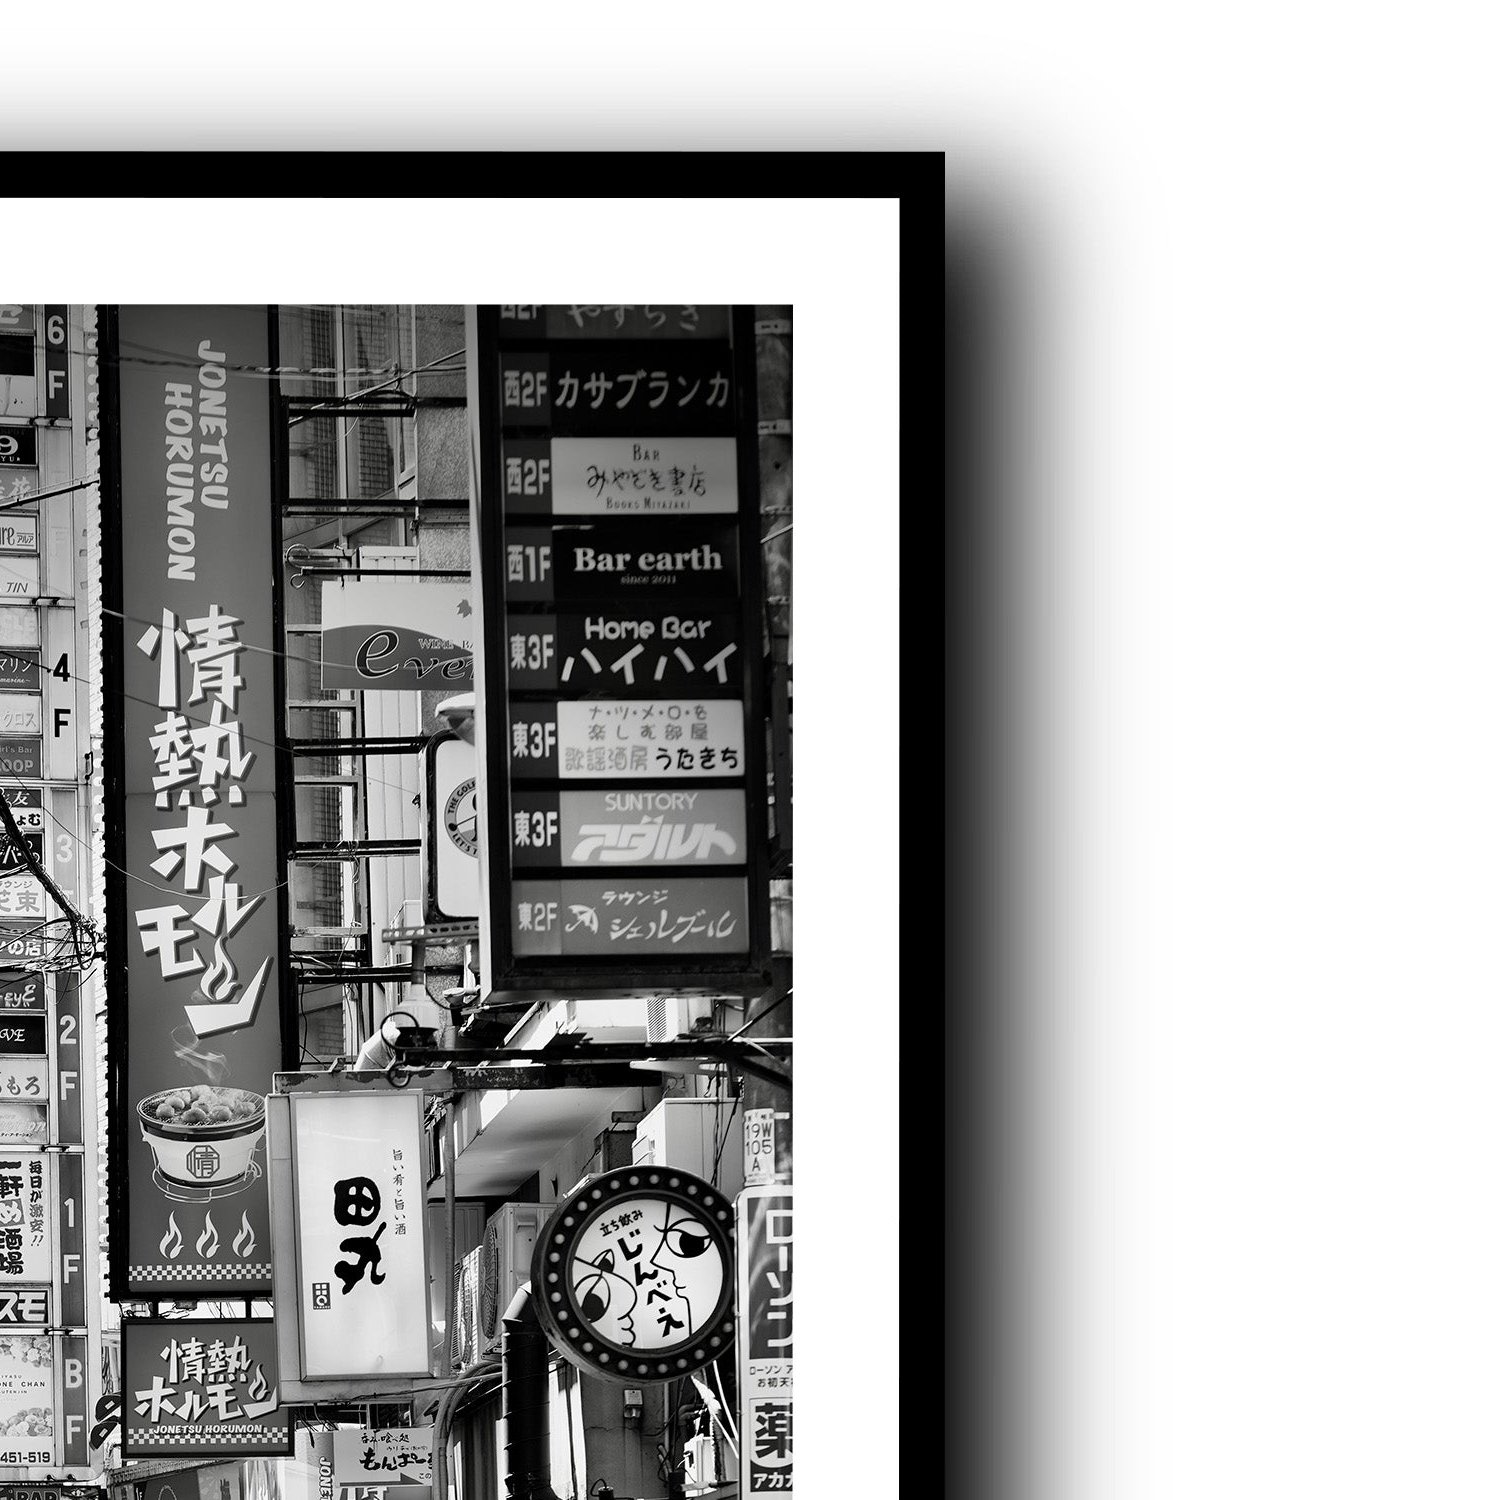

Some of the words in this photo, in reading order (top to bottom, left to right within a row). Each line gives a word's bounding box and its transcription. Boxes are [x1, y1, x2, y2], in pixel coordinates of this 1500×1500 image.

[504, 369, 548, 408] 西2F
[554, 368, 730, 409] カサブランカ
[197, 339, 229, 510] JONETSU
[164, 382, 197, 582] HORUMON
[506, 457, 551, 496] 西2F
[507, 544, 551, 583] 西1F
[573, 547, 632, 572] Bar
[638, 544, 723, 571] earth
[6, 582, 29, 593] TIN
[620, 573, 650, 584] since
[584, 616, 655, 640] Home
[661, 616, 713, 640] Bar
[418, 637, 455, 650] WINE
[510, 633, 555, 670] 東3F
[560, 642, 739, 685] ハイハイ
[512, 721, 557, 759] 東3F
[588, 723, 709, 741] 楽しむ部屋
[17, 745, 33, 754] Bar
[564, 745, 649, 772] 歌謡酒房
[655, 746, 739, 771] うたきち
[11, 790, 31, 806] 友
[447, 797, 459, 815] THE
[604, 792, 699, 812] SUNTORY
[134, 603, 275, 1038] 情熱ホルモン
[513, 810, 558, 848] 東3F
[452, 833, 471, 853] LET'S
[601, 889, 669, 906] ラウンジ
[518, 901, 558, 932] 東2F
[609, 908, 738, 944] シェルブール
[745, 1122, 773, 1139] 19W
[745, 1138, 773, 1156] 105
[751, 1157, 761, 1172] A
[392, 1149, 407, 1236] 旨い肴と旨い酒
[599, 1208, 644, 1238] 立ち飲み
[617, 1228, 685, 1338] じんべえ
[159, 1335, 253, 1385] 情熱
[749, 1366, 782, 1375] ローソン
[134, 1374, 278, 1423] ホルモン
[152, 1424, 203, 1434] JONETSU
[205, 1424, 263, 1434] HORUMON
